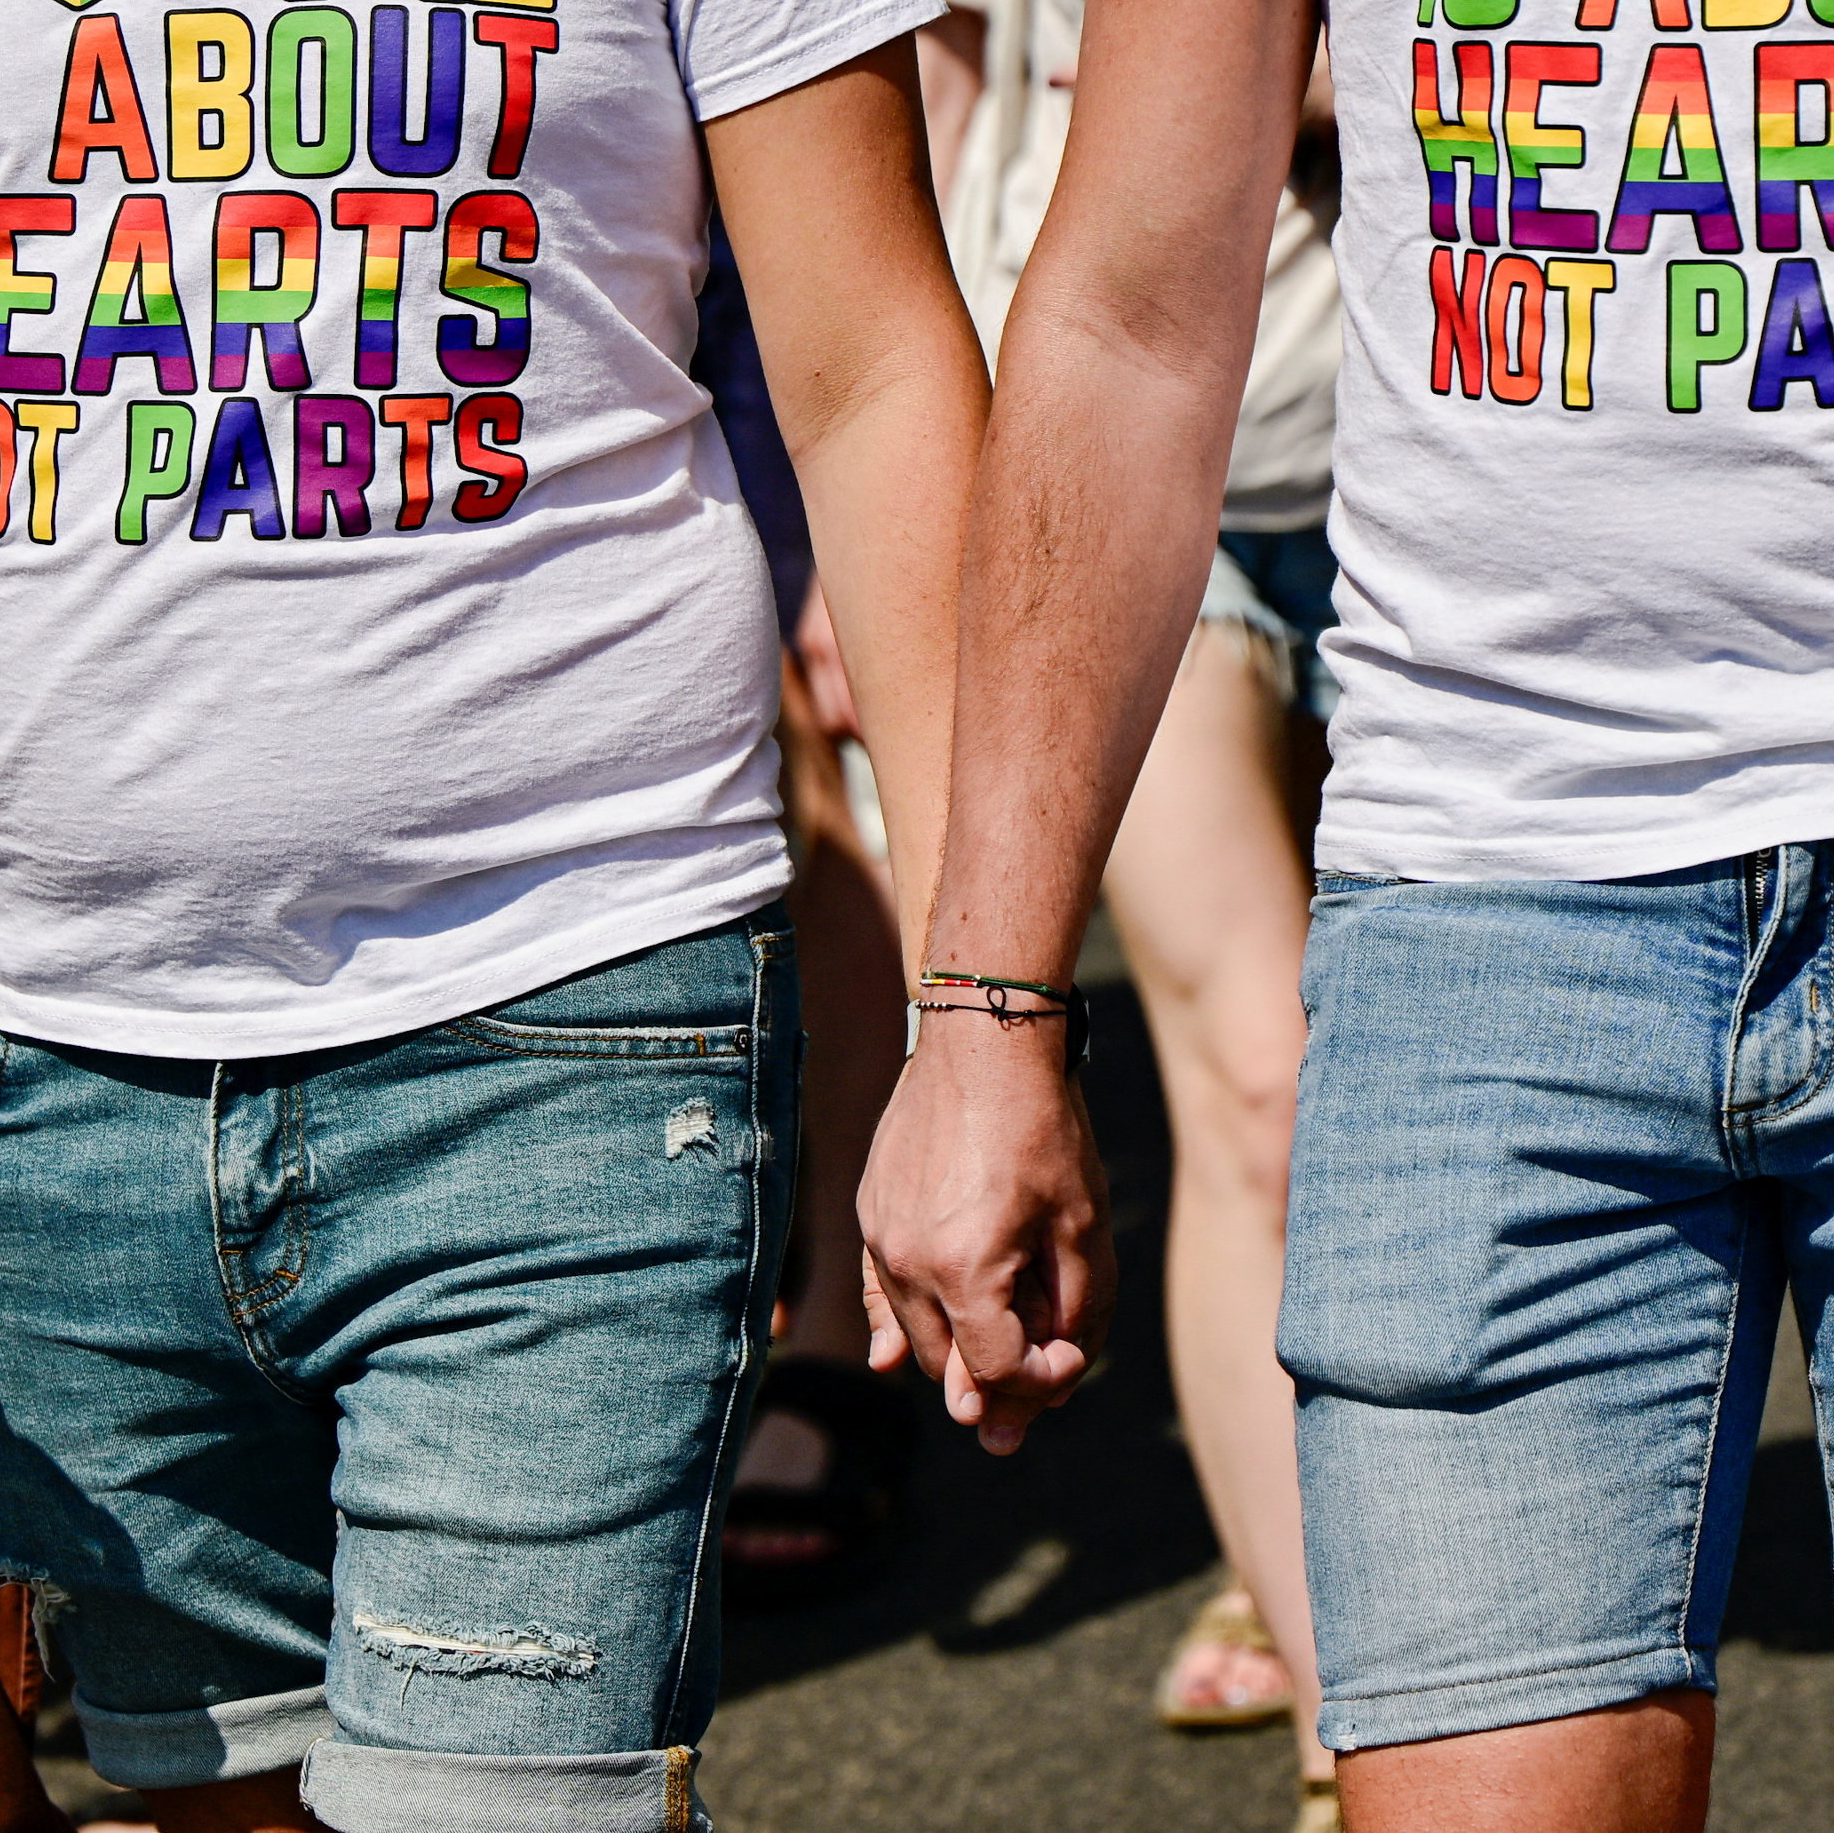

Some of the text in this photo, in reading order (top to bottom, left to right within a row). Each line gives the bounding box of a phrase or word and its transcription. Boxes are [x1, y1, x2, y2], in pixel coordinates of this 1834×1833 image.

[48, 4, 559, 184] ABOUT
[1429, 244, 1617, 411] NOT
[113, 391, 529, 545] PARTS
